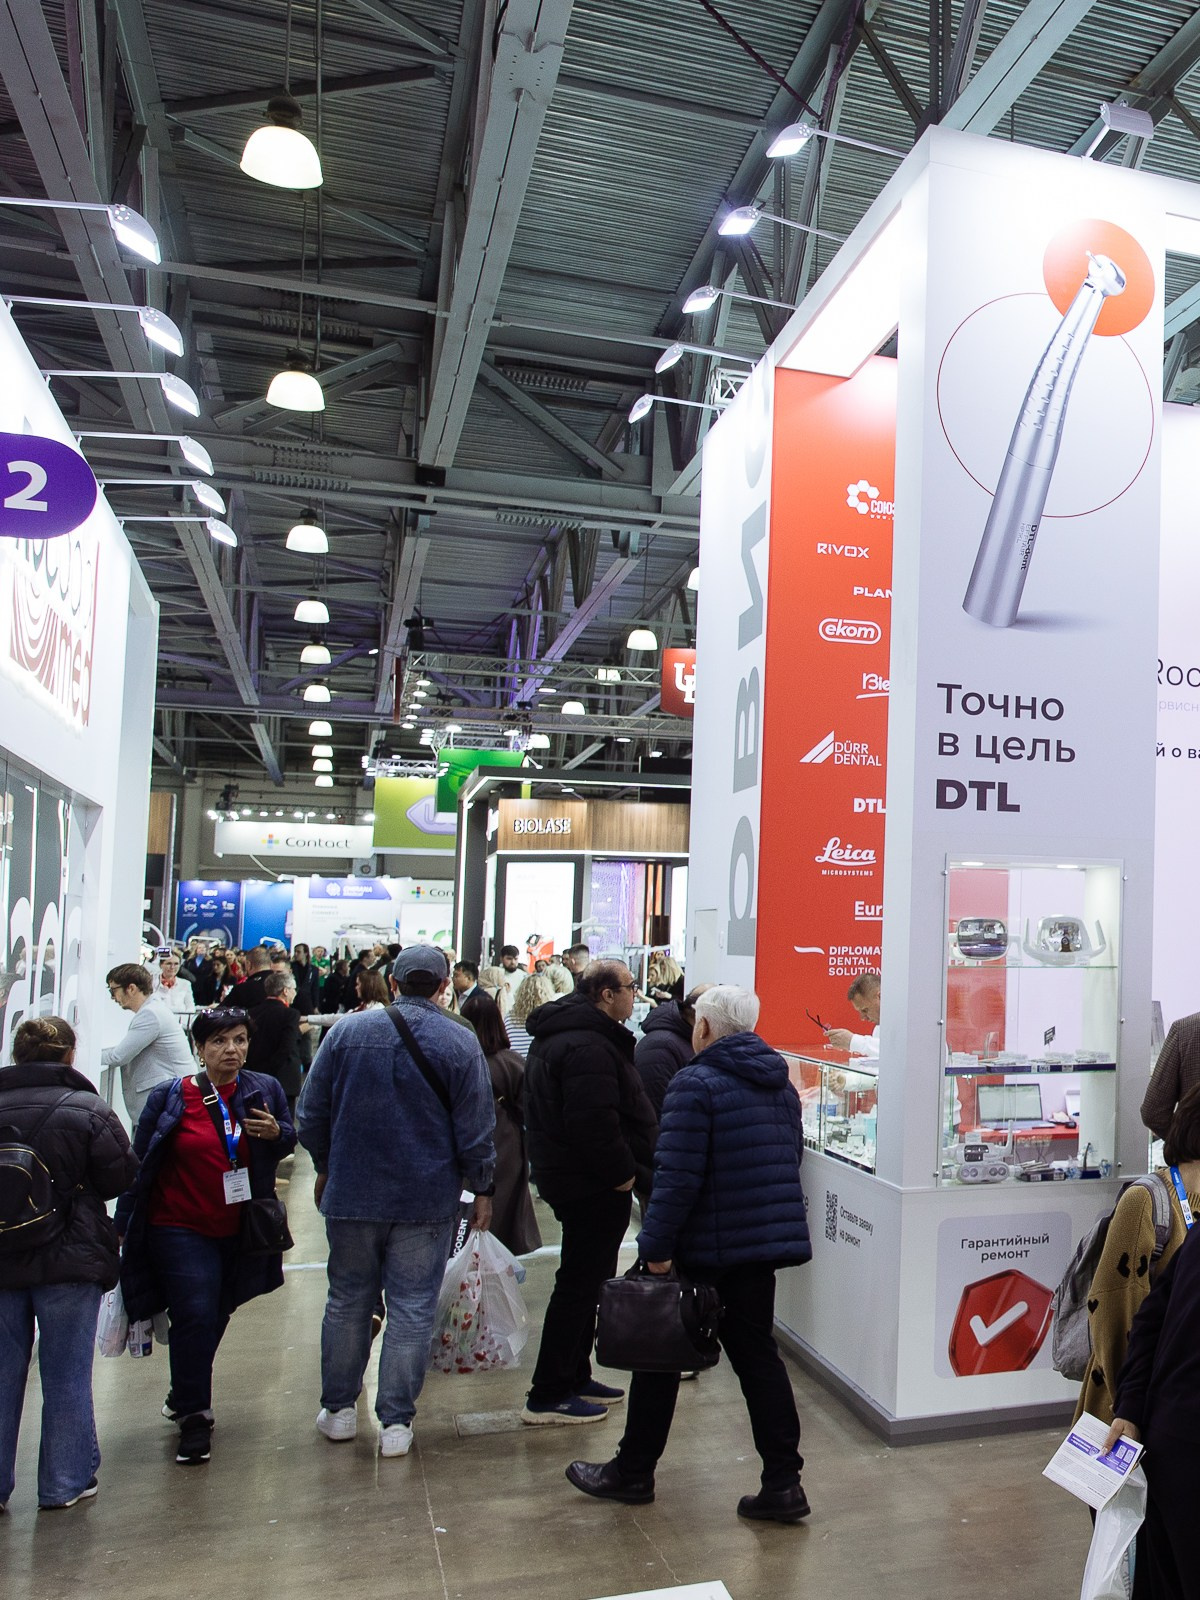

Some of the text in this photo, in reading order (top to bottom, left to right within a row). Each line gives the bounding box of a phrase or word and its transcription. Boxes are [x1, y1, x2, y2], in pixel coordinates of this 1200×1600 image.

[3, 459, 49, 512] 2
[870, 499, 895, 515] СОЮ
[825, 619, 875, 639] ekom
[936, 682, 1065, 722] Точно
[834, 740, 869, 754] DÜRR
[937, 732, 1076, 763] в цель
[1171, 747, 1182, 758] о
[834, 754, 882, 766] DENTAL
[935, 778, 1021, 813] DTL
[853, 798, 886, 814] DTL
[513, 817, 571, 834] BIOLASE
[285, 836, 351, 849] Contact
[814, 836, 877, 866] Leica
[829, 957, 872, 966] DENTAL
[961, 1233, 1050, 1250] Гарантийный
[981, 1249, 1030, 1263] ремонт
